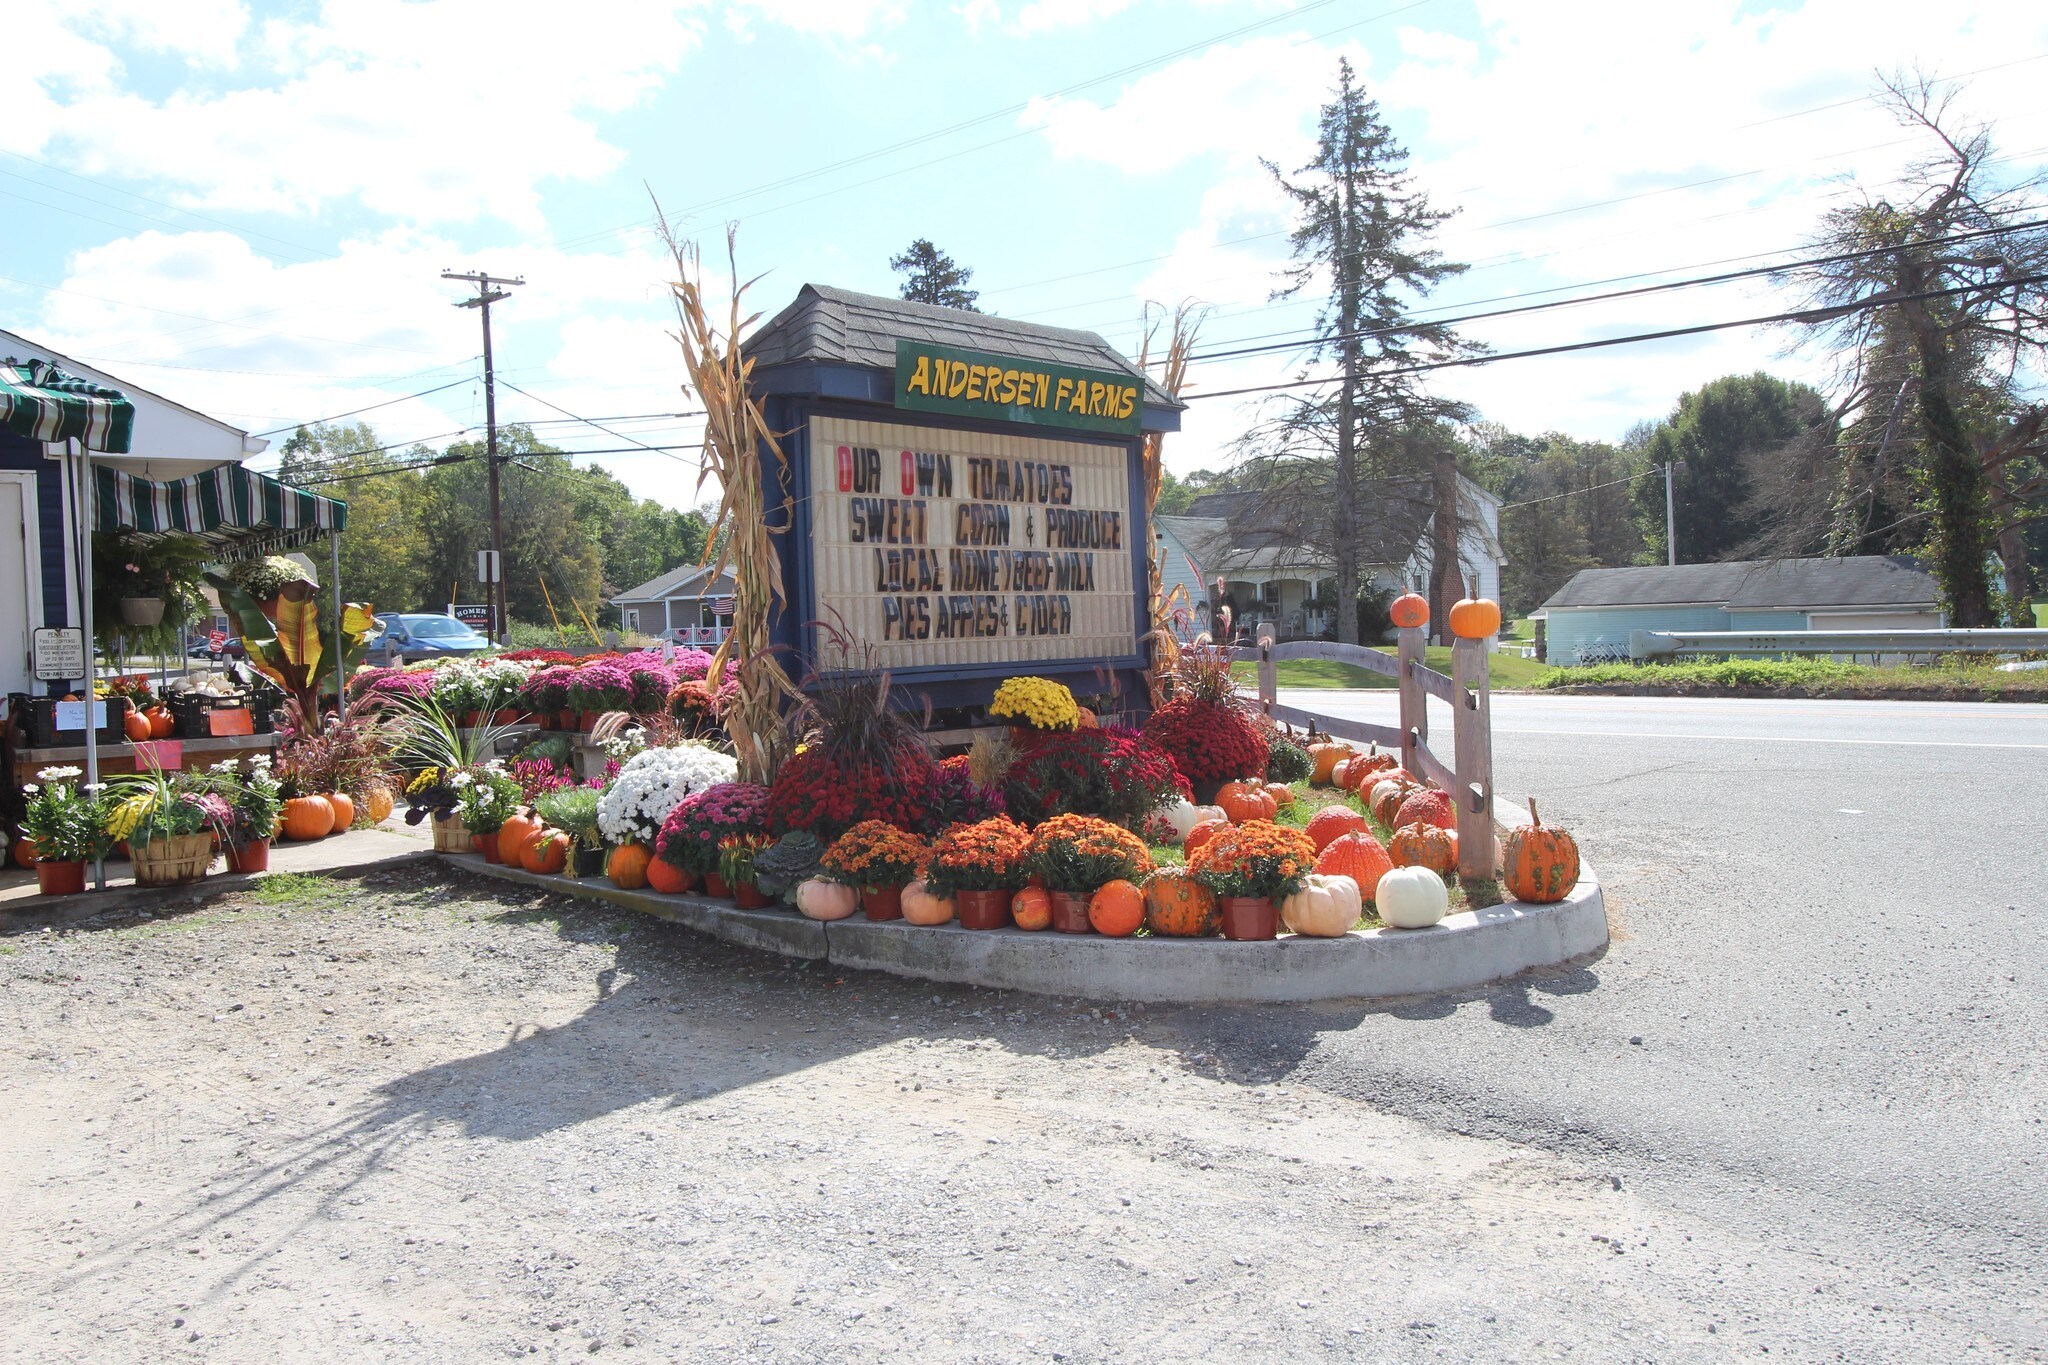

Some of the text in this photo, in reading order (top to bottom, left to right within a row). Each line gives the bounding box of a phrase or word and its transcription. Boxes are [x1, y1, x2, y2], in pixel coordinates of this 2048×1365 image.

[907, 355, 1138, 420] ANDERSEN FARMS
[837, 445, 1073, 505] OUR OWN TOMATOES
[851, 497, 928, 543] SWEET
[955, 502, 1010, 546] CORN
[1045, 507, 1121, 549] PRODUCE
[874, 548, 1095, 592] LOCAL HONEY BEEF MILK
[882, 595, 931, 641] PIES
[1015, 594, 1072, 635] CIDER
